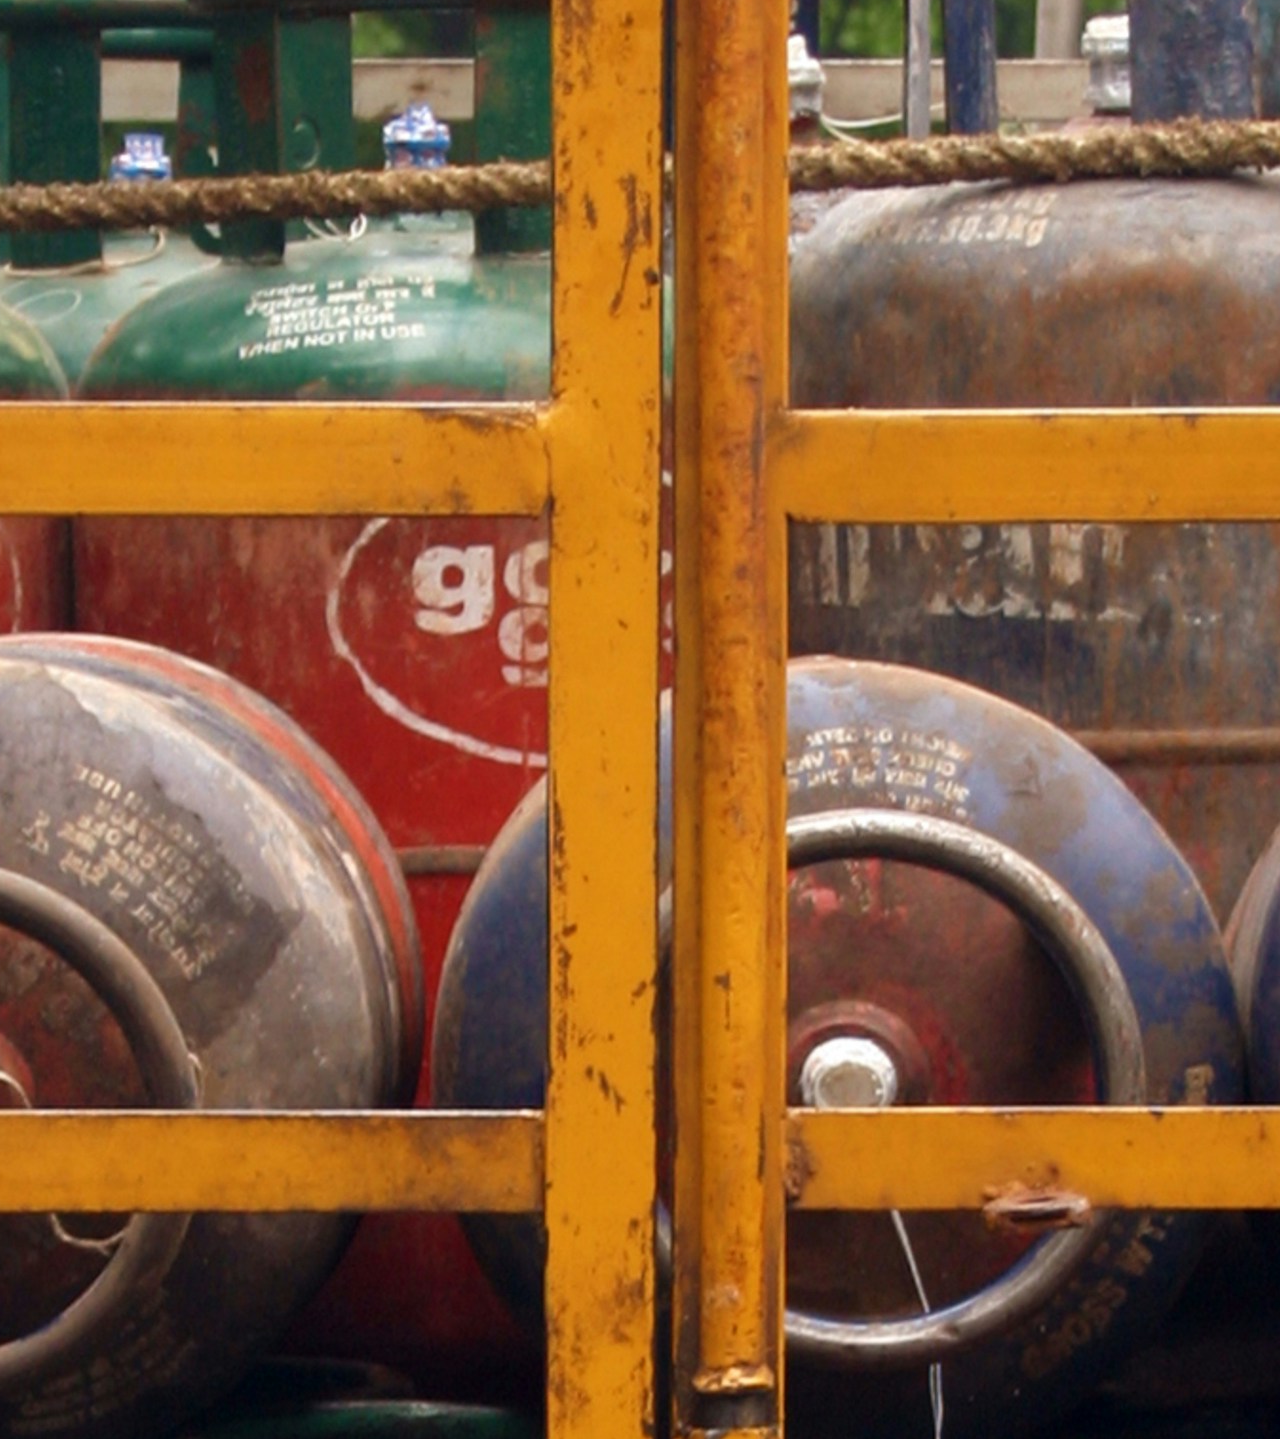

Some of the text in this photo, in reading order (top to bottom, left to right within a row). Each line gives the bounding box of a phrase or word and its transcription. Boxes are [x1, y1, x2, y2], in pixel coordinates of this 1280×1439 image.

[302, 330, 348, 348] NOT
[353, 324, 376, 342] IN
[380, 322, 427, 340] USE
